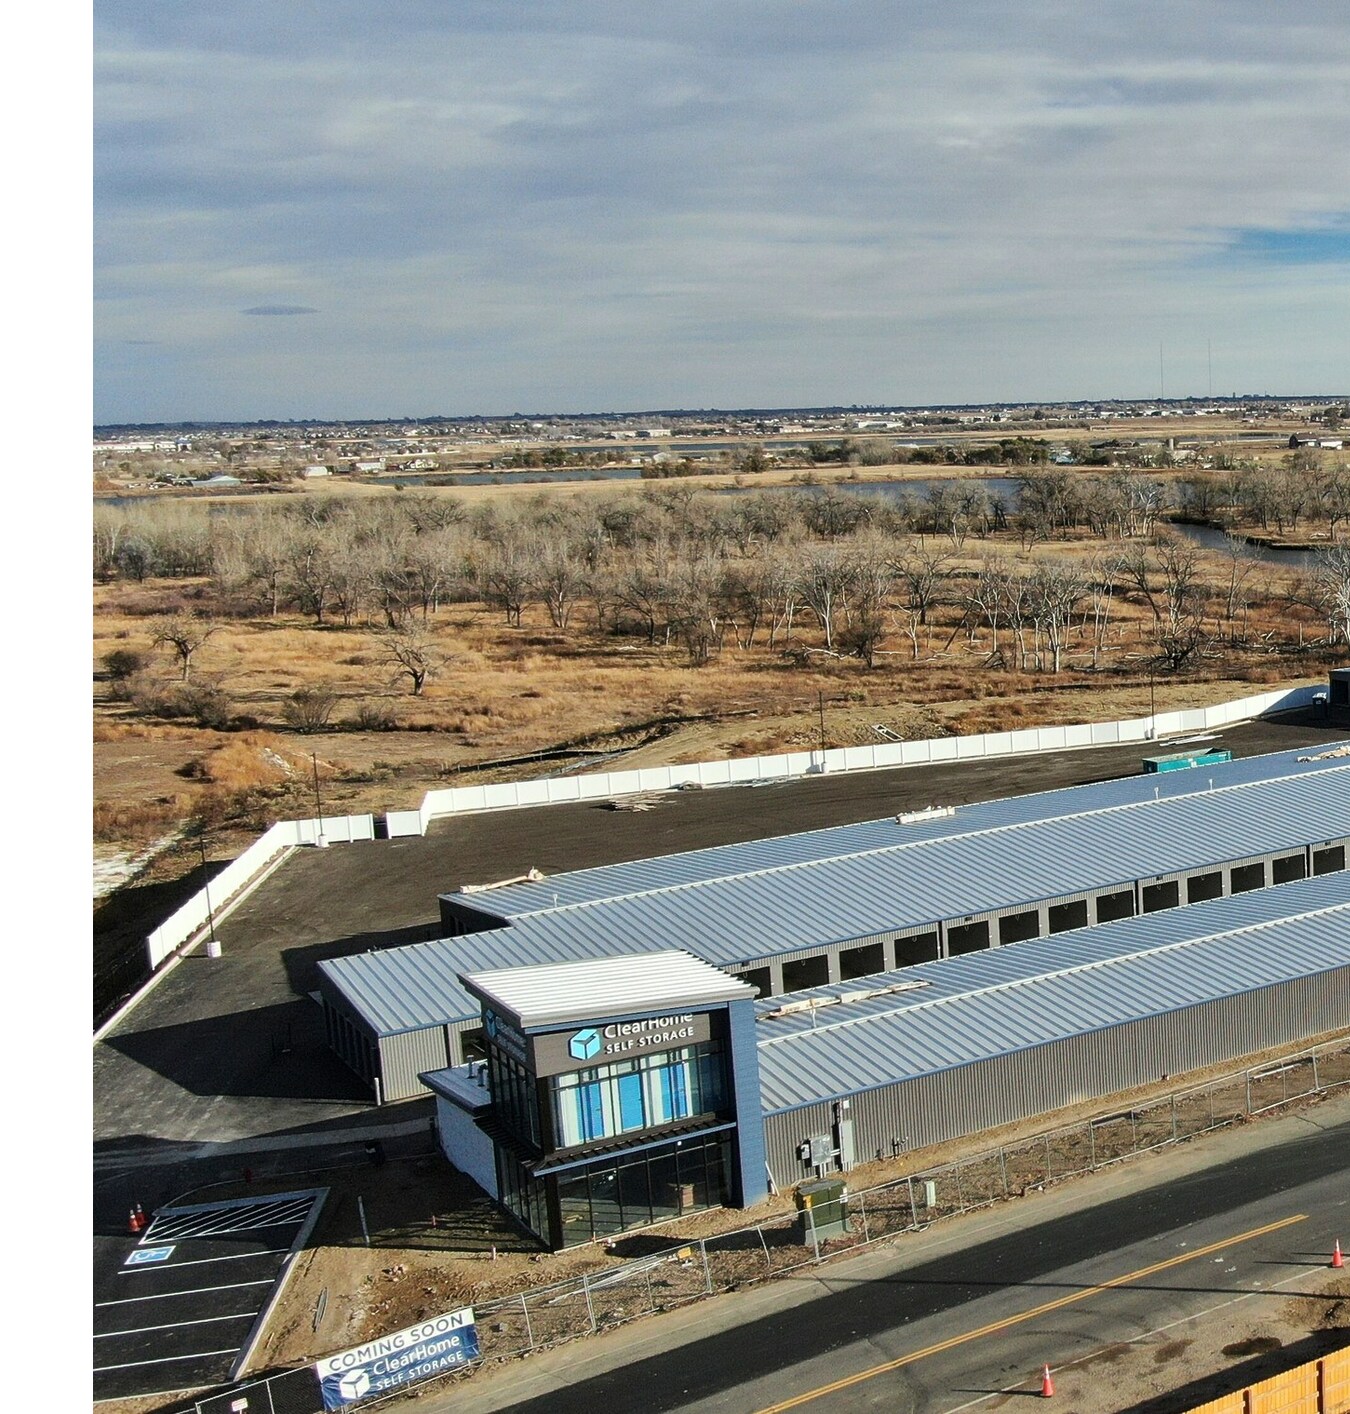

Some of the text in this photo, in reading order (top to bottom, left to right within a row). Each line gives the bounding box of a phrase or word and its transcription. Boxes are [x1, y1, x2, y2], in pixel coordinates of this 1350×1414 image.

[606, 1027, 694, 1055] SELF STORAGE
[330, 1313, 463, 1372] COMING SOON
[373, 1334, 461, 1376] ClearHome
[377, 1351, 463, 1391] SELF STORAGE
